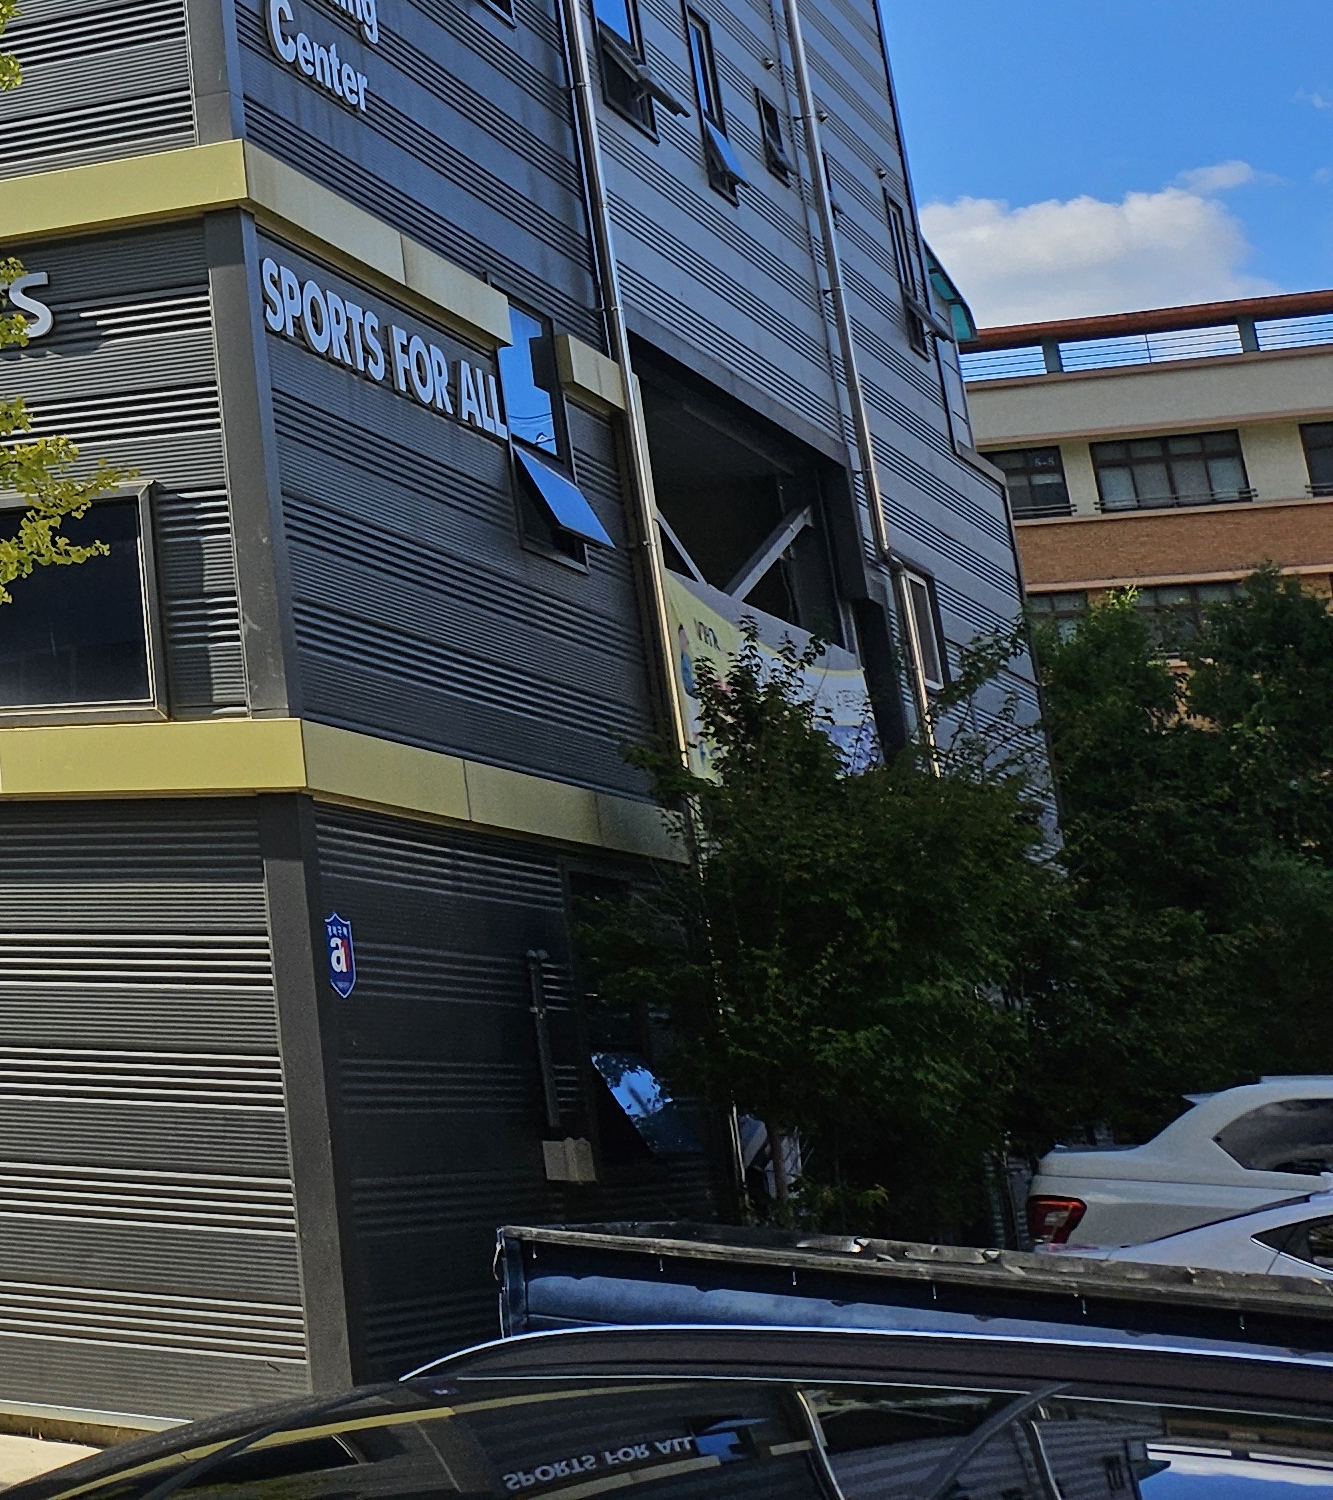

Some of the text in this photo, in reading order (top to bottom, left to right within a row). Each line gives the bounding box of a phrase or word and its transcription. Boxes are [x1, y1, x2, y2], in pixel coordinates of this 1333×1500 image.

[262, 257, 509, 441] SPORTS FOR ALL
